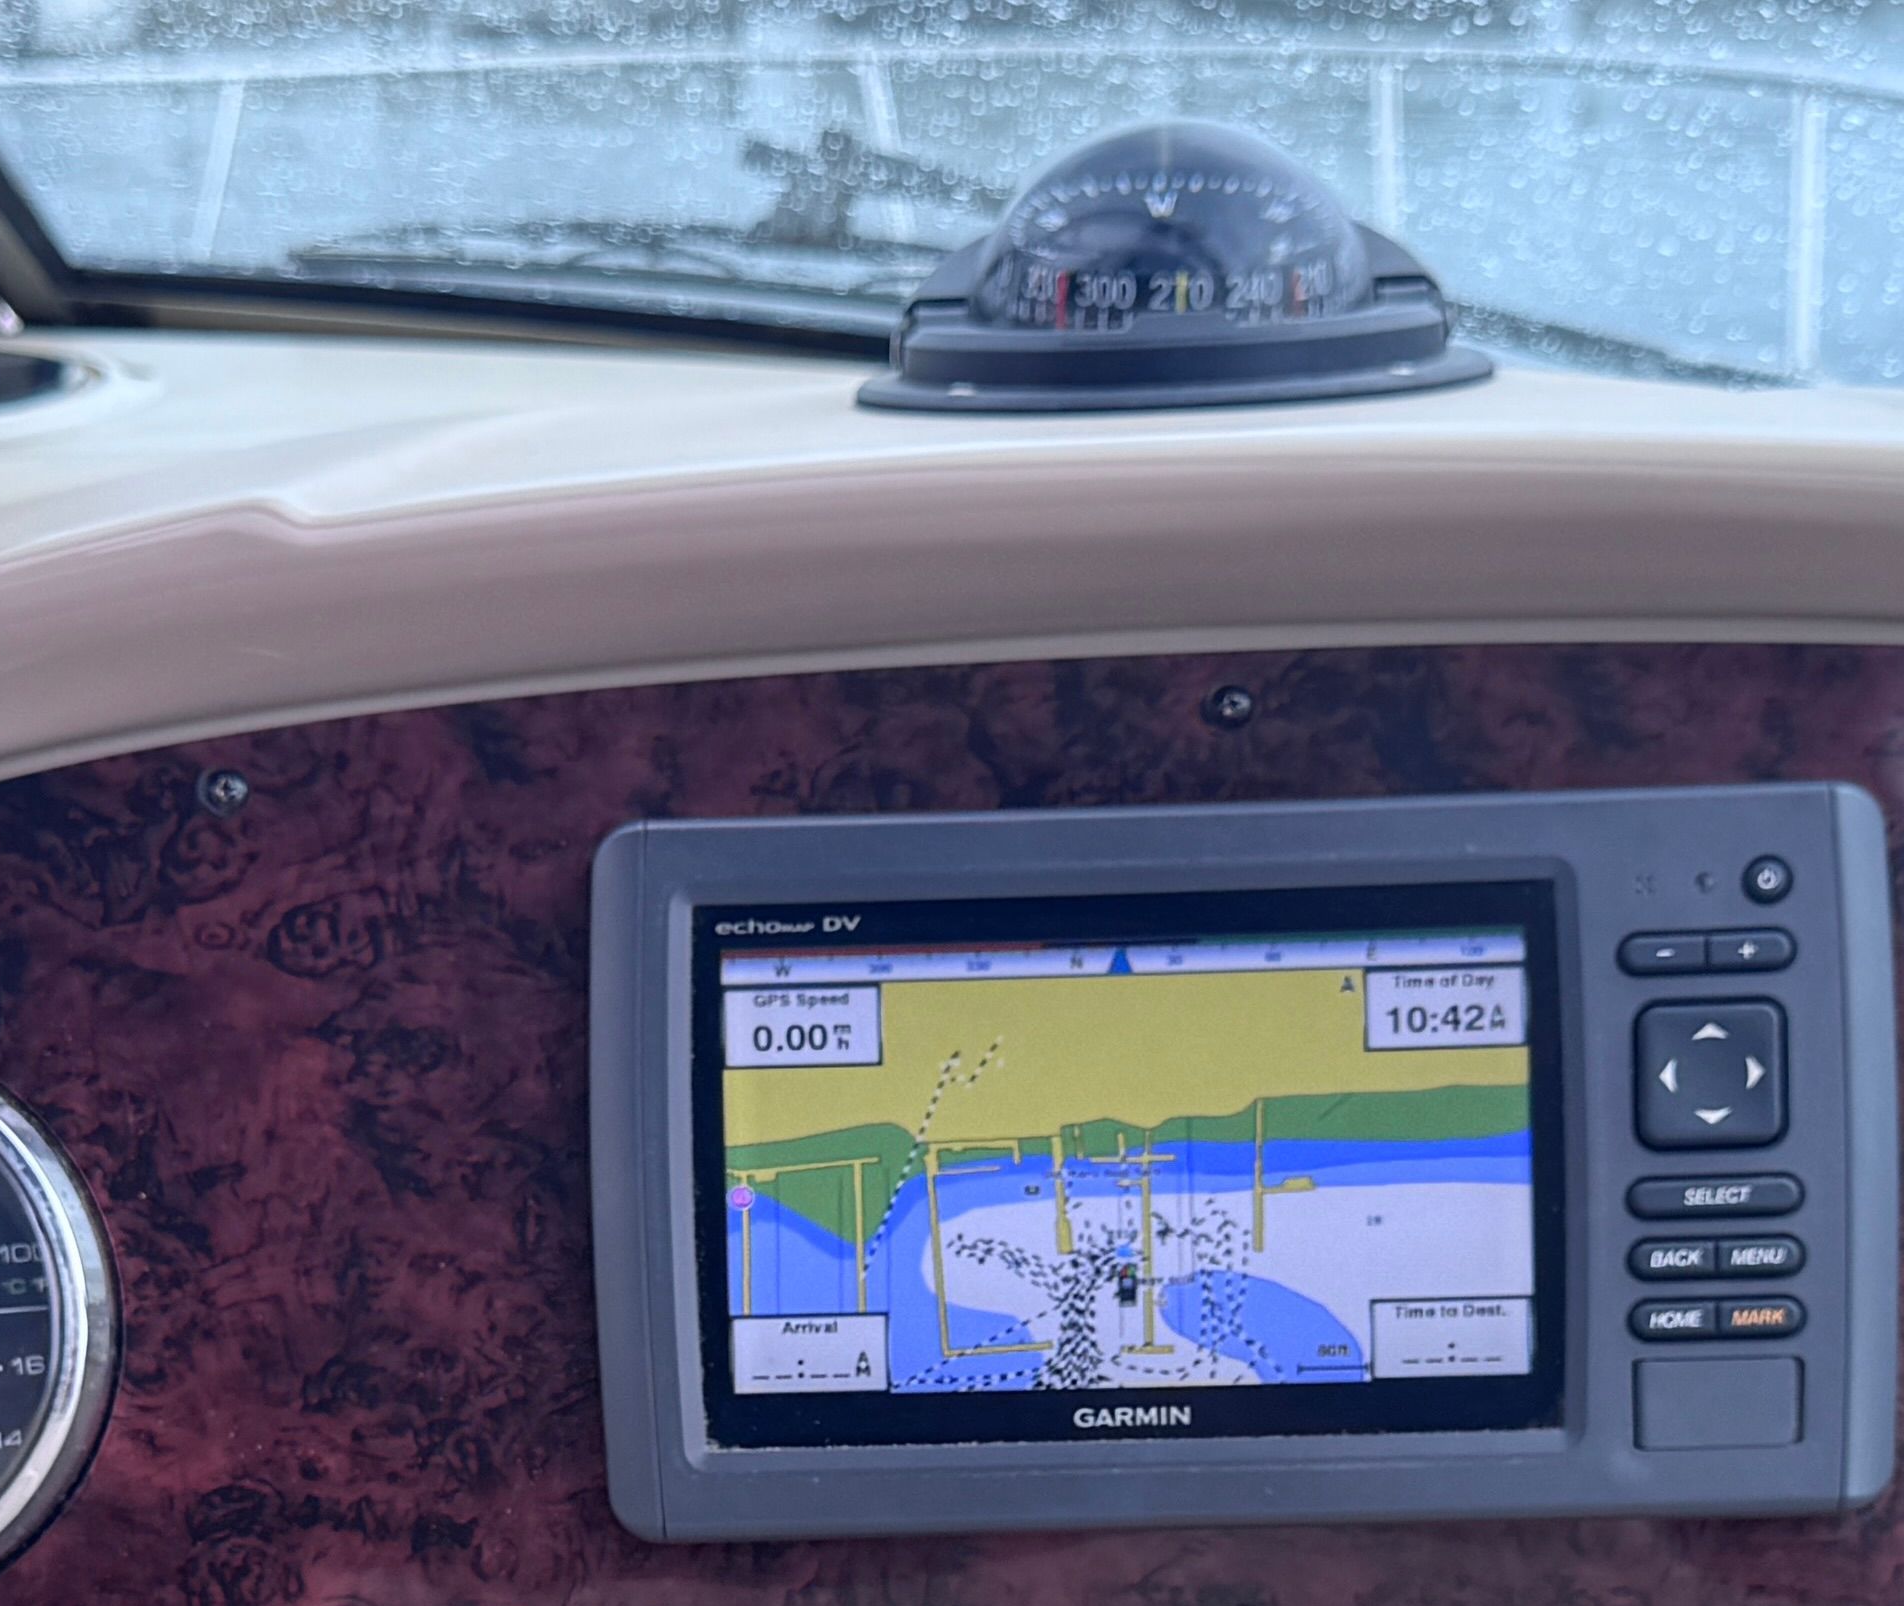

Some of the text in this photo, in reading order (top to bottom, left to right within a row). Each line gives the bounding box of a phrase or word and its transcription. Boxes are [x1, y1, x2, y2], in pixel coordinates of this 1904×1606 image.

[823, 916, 861, 932] DV
[1394, 973, 1494, 990] Time of Day
[753, 992, 850, 1010] GPS Speed
[1385, 1005, 1485, 1035] 10:42
[753, 1024, 829, 1053] 0.00
[1683, 1186, 1752, 1206] SELECT
[1649, 1249, 1702, 1268] BACK
[1730, 1248, 1785, 1266] MENU
[1395, 1305, 1507, 1319] Time to Dest.
[1649, 1309, 1702, 1329] HOME
[1731, 1308, 1785, 1327] MARK
[782, 1321, 838, 1334] Arrival
[9, 1357, 46, 1376] 16
[1073, 1406, 1192, 1431] GARMIN
